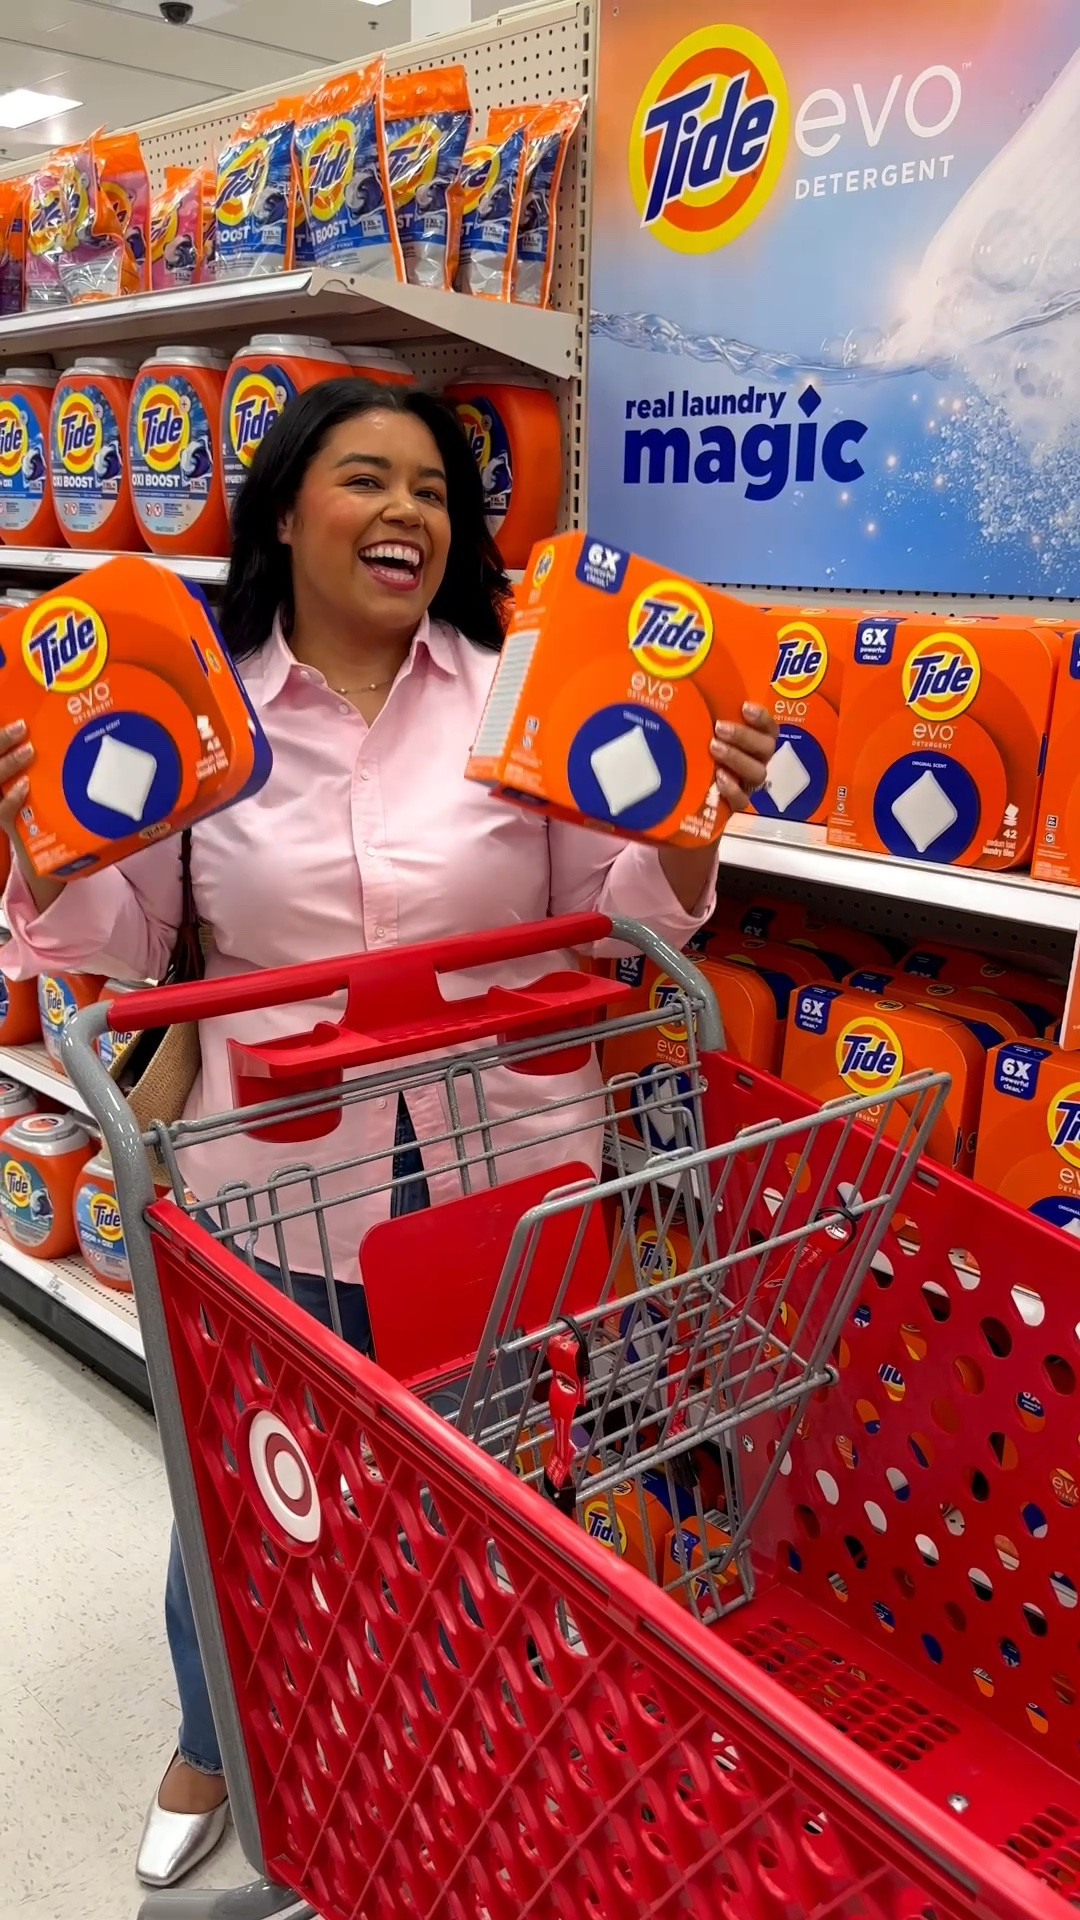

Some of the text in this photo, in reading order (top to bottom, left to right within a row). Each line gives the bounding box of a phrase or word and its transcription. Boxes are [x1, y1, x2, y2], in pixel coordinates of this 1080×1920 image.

[639, 69, 778, 228] Tide
[795, 155, 954, 200] DETERGENT
[316, 218, 348, 244] BOOST
[625, 386, 787, 419] real laundry
[60, 412, 97, 460] Tide
[141, 405, 184, 455] Tide
[624, 384, 869, 501] magic
[64, 476, 94, 489] BOOST
[132, 473, 144, 487] OXI
[145, 474, 180, 488] BOOST
[588, 543, 621, 576] 6X
[630, 598, 706, 656] Tide
[861, 628, 889, 646] 6X
[28, 610, 98, 691] Tide
[770, 639, 822, 685] Tide
[631, 671, 674, 702] evo
[905, 653, 974, 706] Tide
[67, 682, 110, 715] evo
[775, 700, 808, 716] evo
[911, 740, 952, 749] DETERGENT
[913, 723, 954, 741] evo
[1003, 829, 1018, 840] 42
[46, 988, 62, 1010] Tide
[801, 998, 825, 1017] 6X
[657, 1040, 686, 1058] evo
[839, 1033, 899, 1076] Tide
[1000, 1075, 1029, 1088] powerful
[1002, 1058, 1032, 1081] 6X
[7, 1171, 28, 1194] Tide
[93, 1204, 121, 1228] Tide
